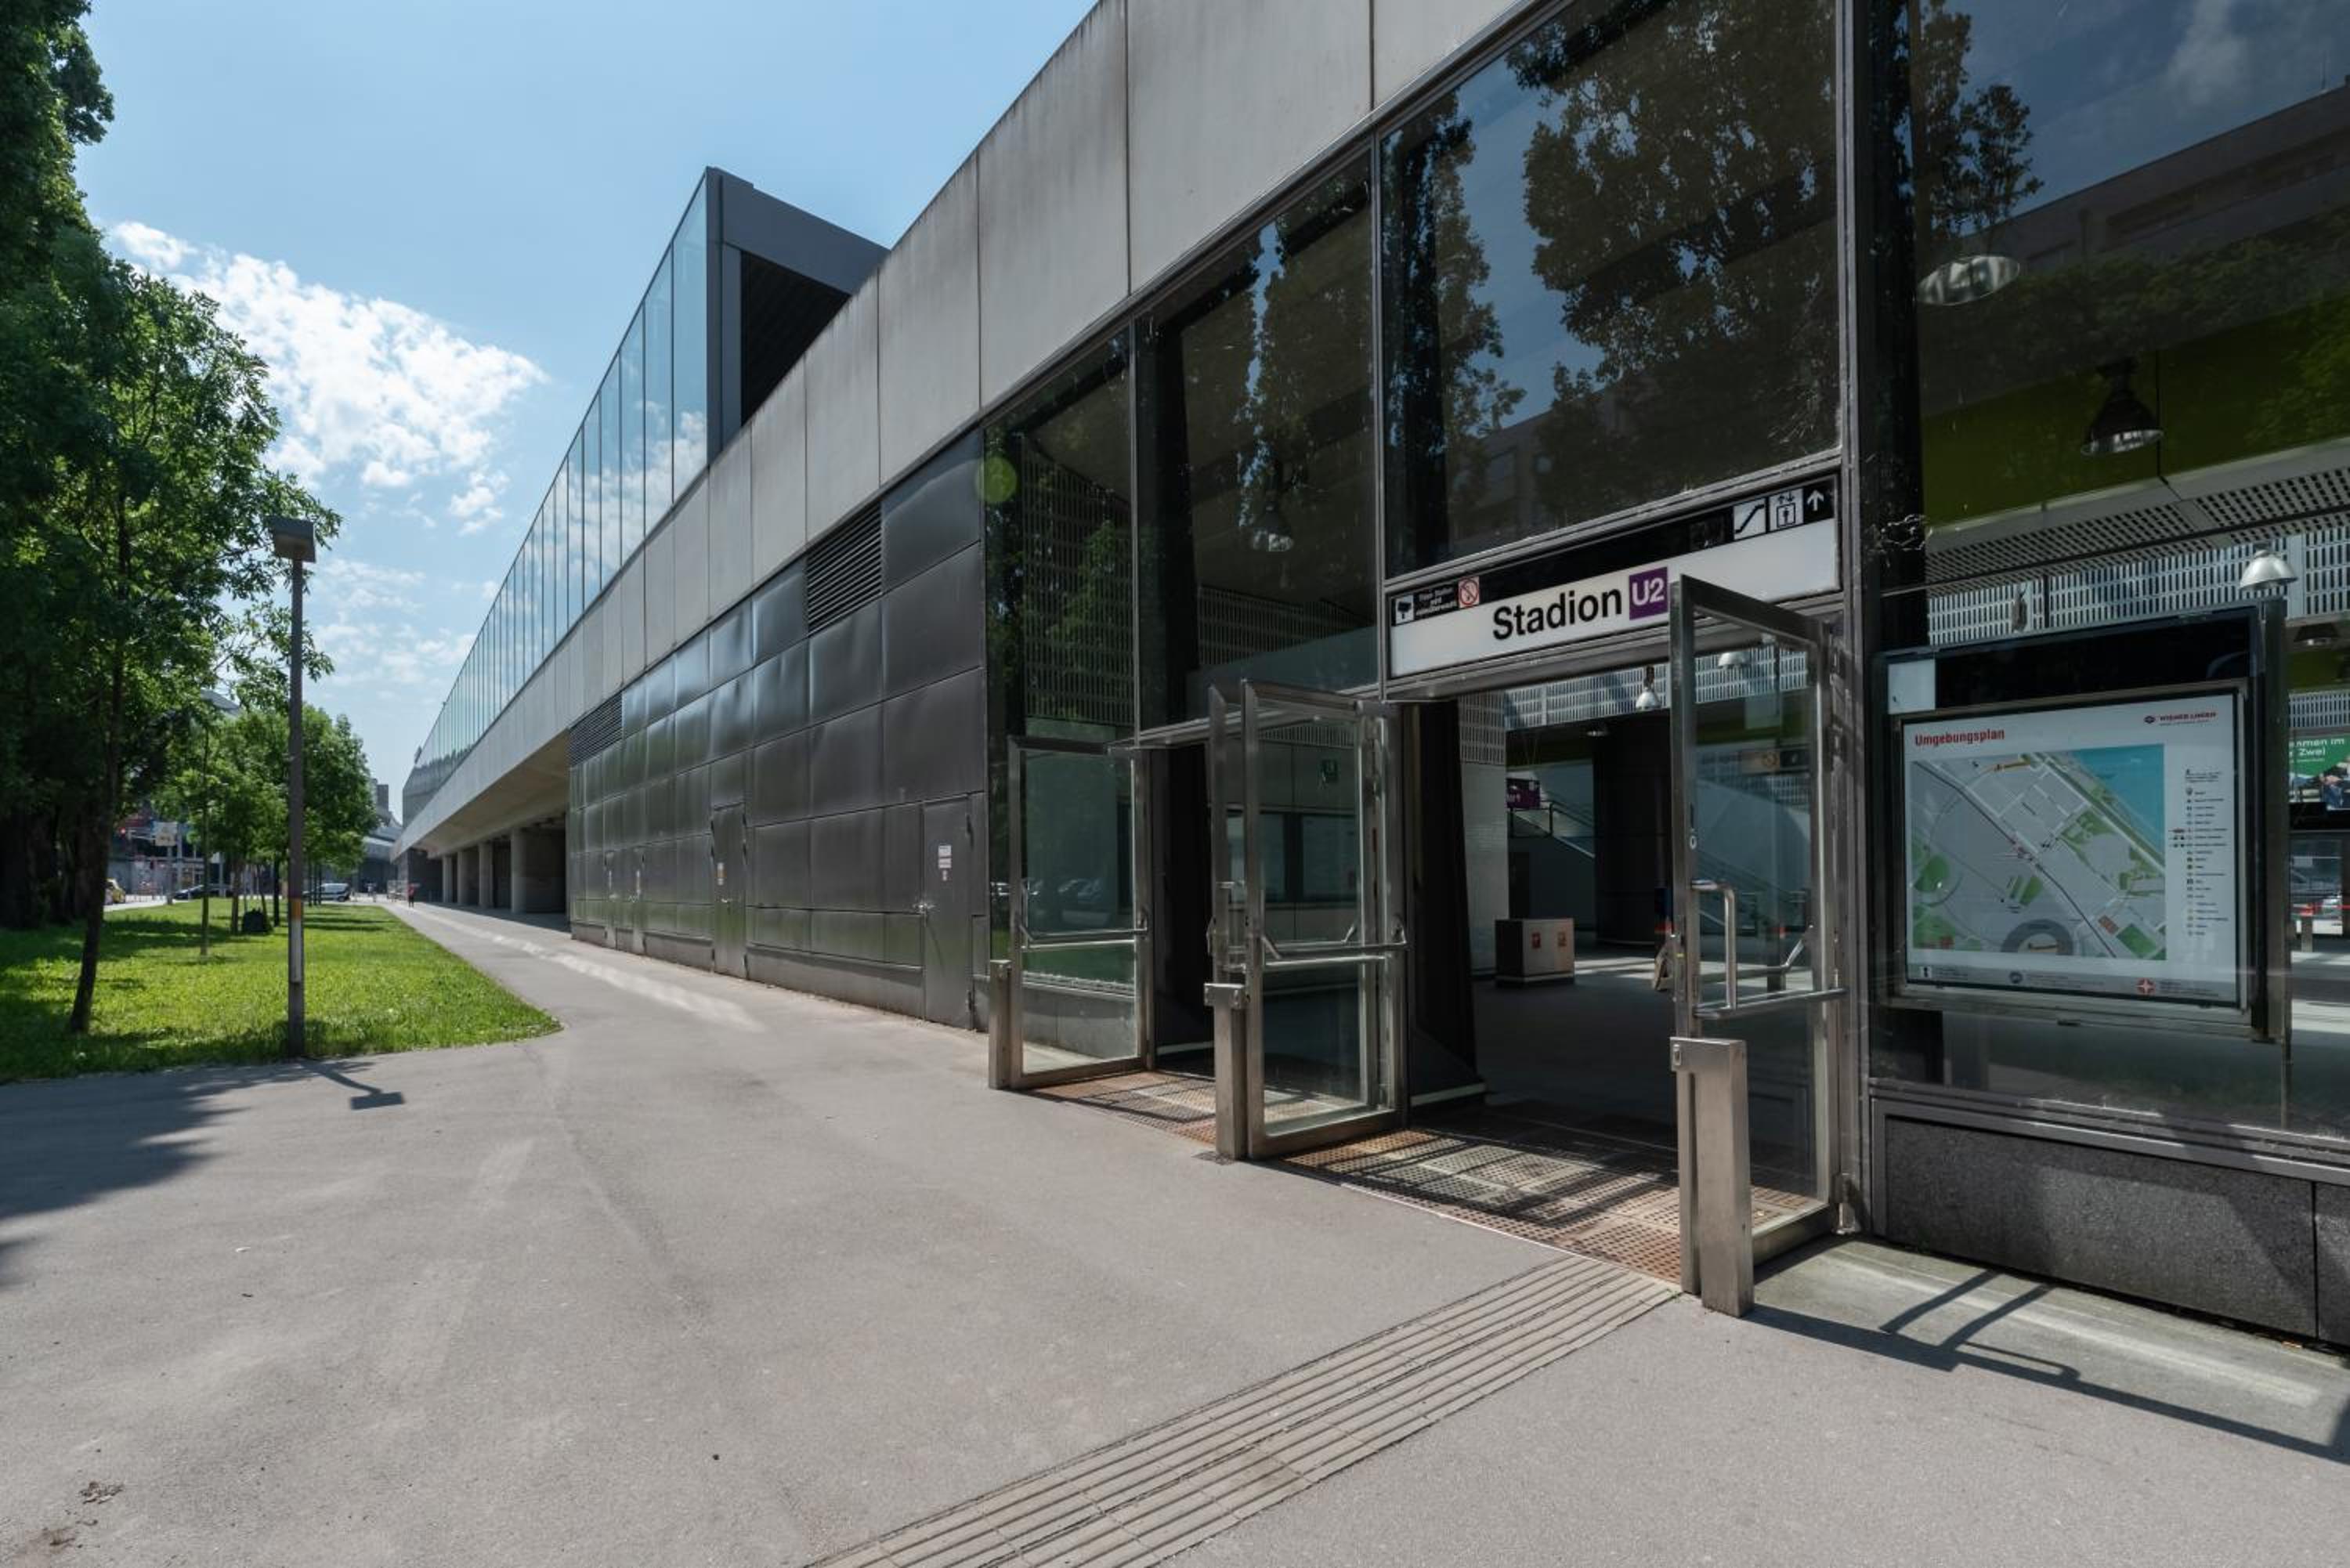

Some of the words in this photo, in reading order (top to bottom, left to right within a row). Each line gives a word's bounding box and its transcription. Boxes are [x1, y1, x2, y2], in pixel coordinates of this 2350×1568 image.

[1493, 588, 1622, 640] Stadion
[1632, 577, 1665, 605] U2
[1915, 728, 2005, 746] Umgebungsplan
